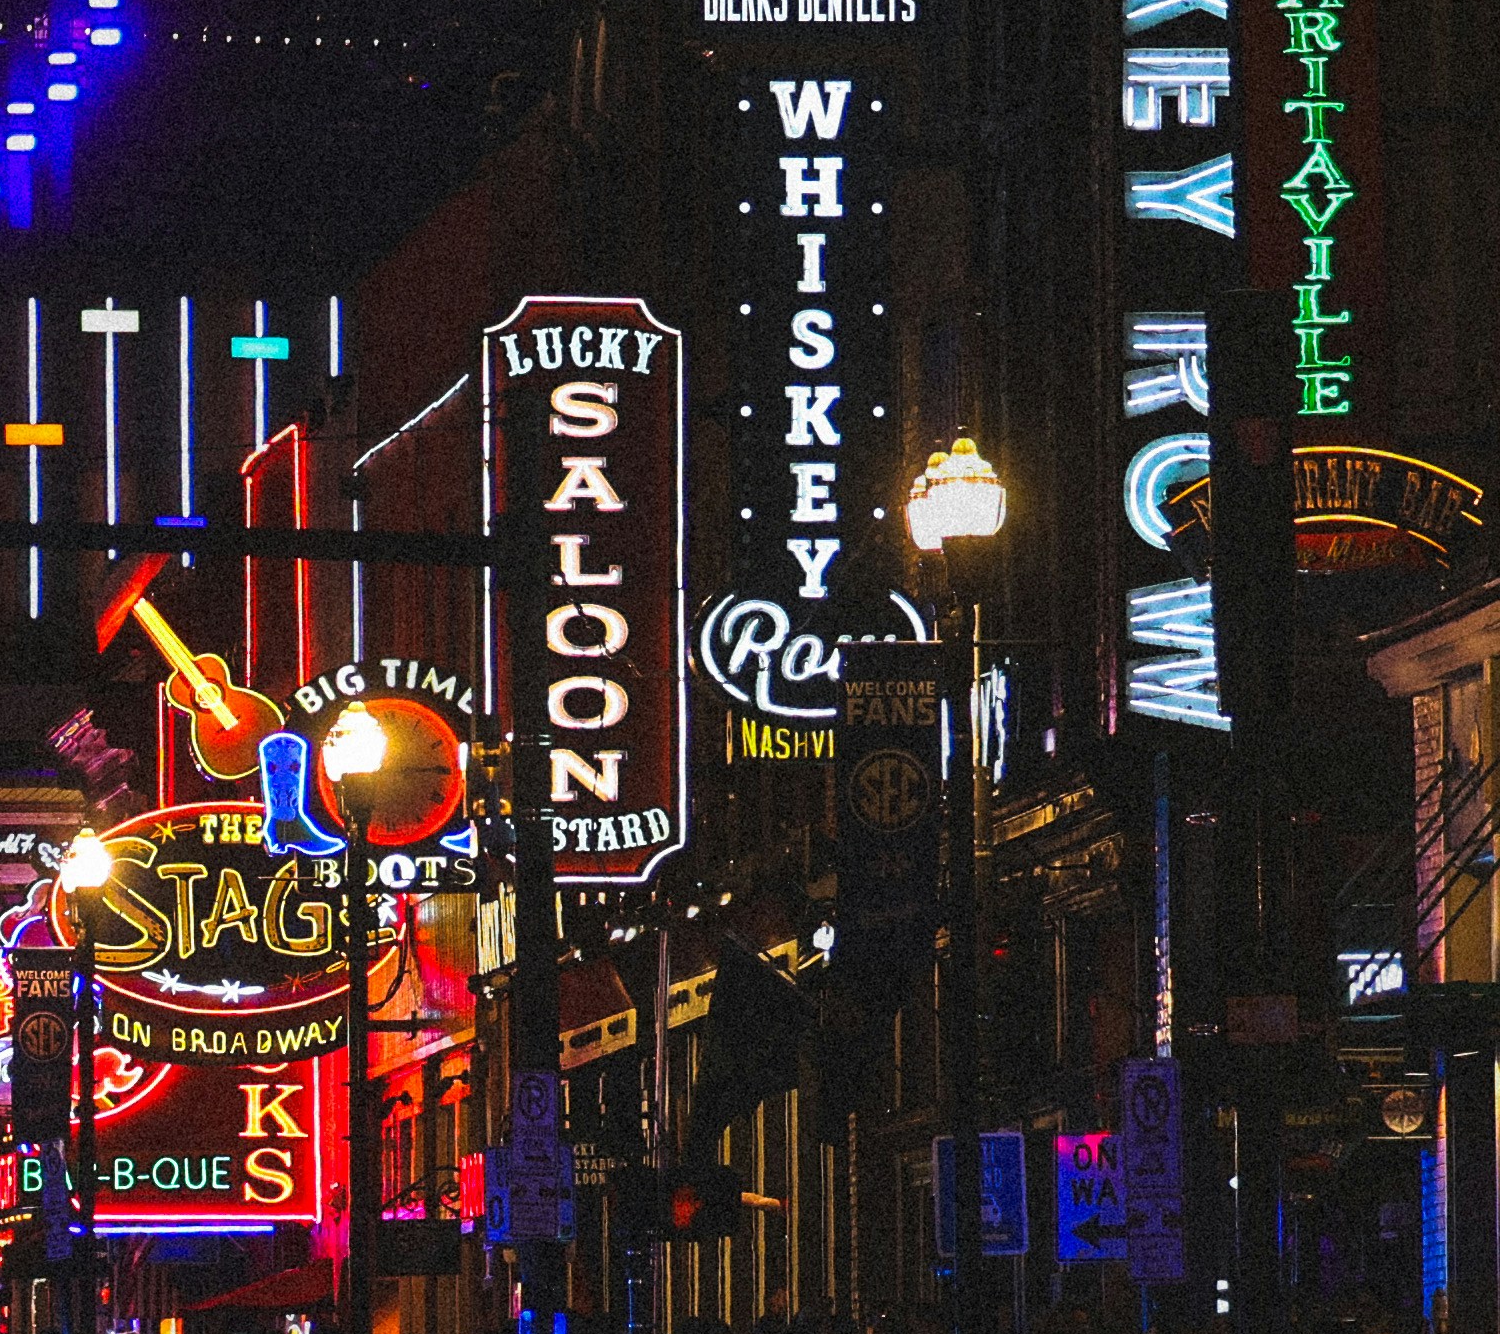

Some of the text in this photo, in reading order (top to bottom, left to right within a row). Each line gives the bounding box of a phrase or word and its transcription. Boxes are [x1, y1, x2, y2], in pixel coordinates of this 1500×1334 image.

[500, 325, 662, 376] LUCKY
[769, 80, 852, 598] WHISKEY
[543, 381, 630, 803] SALOON
[294, 663, 366, 714] BIG
[843, 680, 937, 697] WELCOME
[845, 698, 937, 727] FANS
[199, 813, 264, 845] THE
[94, 836, 350, 972] STAG
[15, 970, 71, 980] WELCOME
[16, 980, 71, 998] FANS
[172, 1015, 343, 1055] BROADWAY
[239, 1063, 309, 1204] KS
[24, 1156, 231, 1193] B-B-QUE
